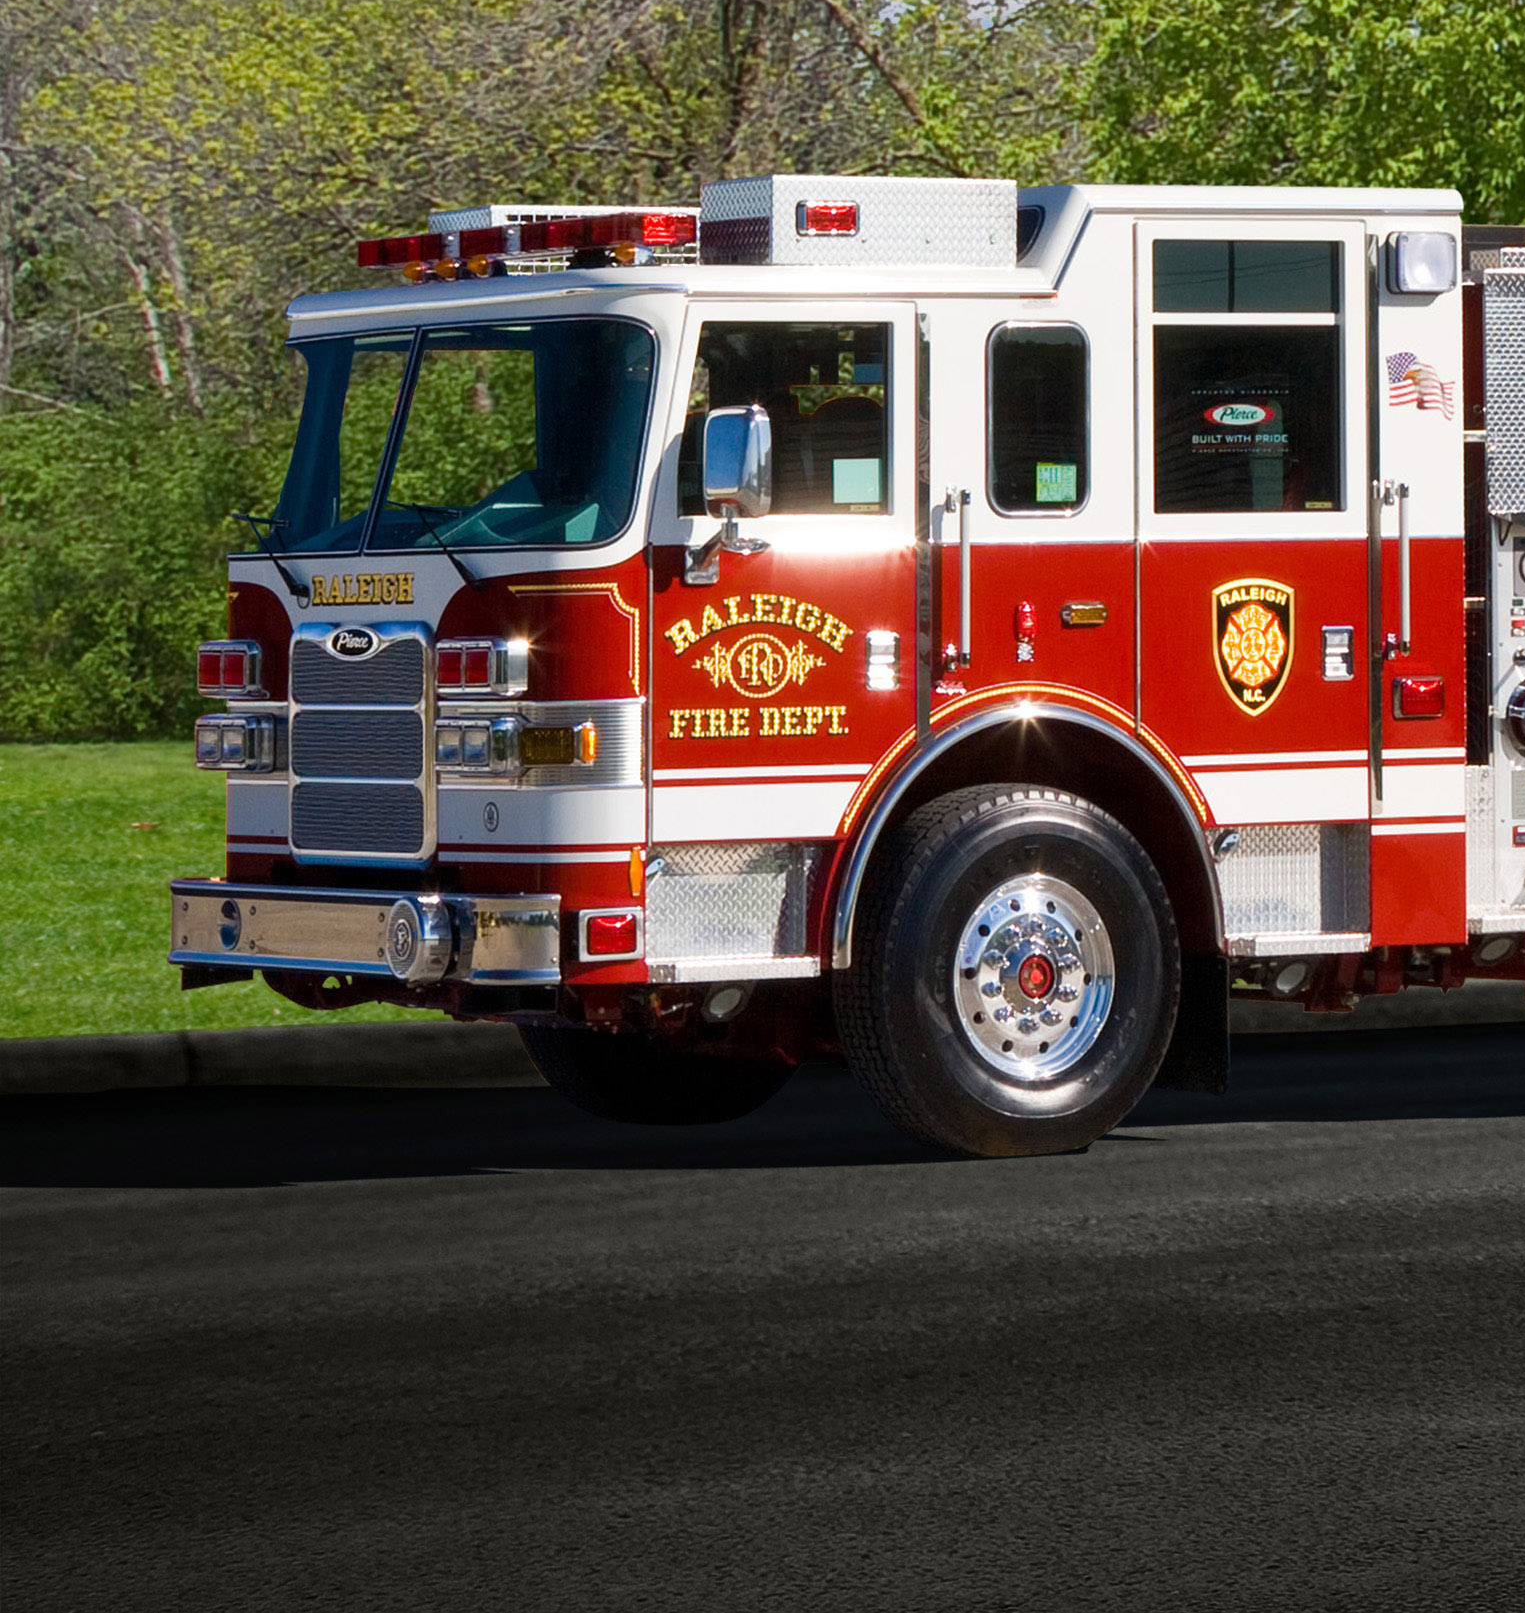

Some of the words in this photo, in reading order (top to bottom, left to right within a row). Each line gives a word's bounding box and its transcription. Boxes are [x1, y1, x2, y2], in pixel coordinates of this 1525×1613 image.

[1220, 406, 1257, 421] Pierce
[1191, 434, 1221, 444] BUILT
[1225, 434, 1251, 443] WITH
[1255, 434, 1288, 443] PRIDE
[312, 574, 414, 606] RALEIGH
[1220, 587, 1287, 607] RALEIGH
[665, 594, 853, 655] RALEIGH
[336, 632, 369, 651] Pierce
[1243, 688, 1266, 702] N.C.
[669, 708, 749, 738] FIRE
[759, 706, 849, 735] DEPT.
